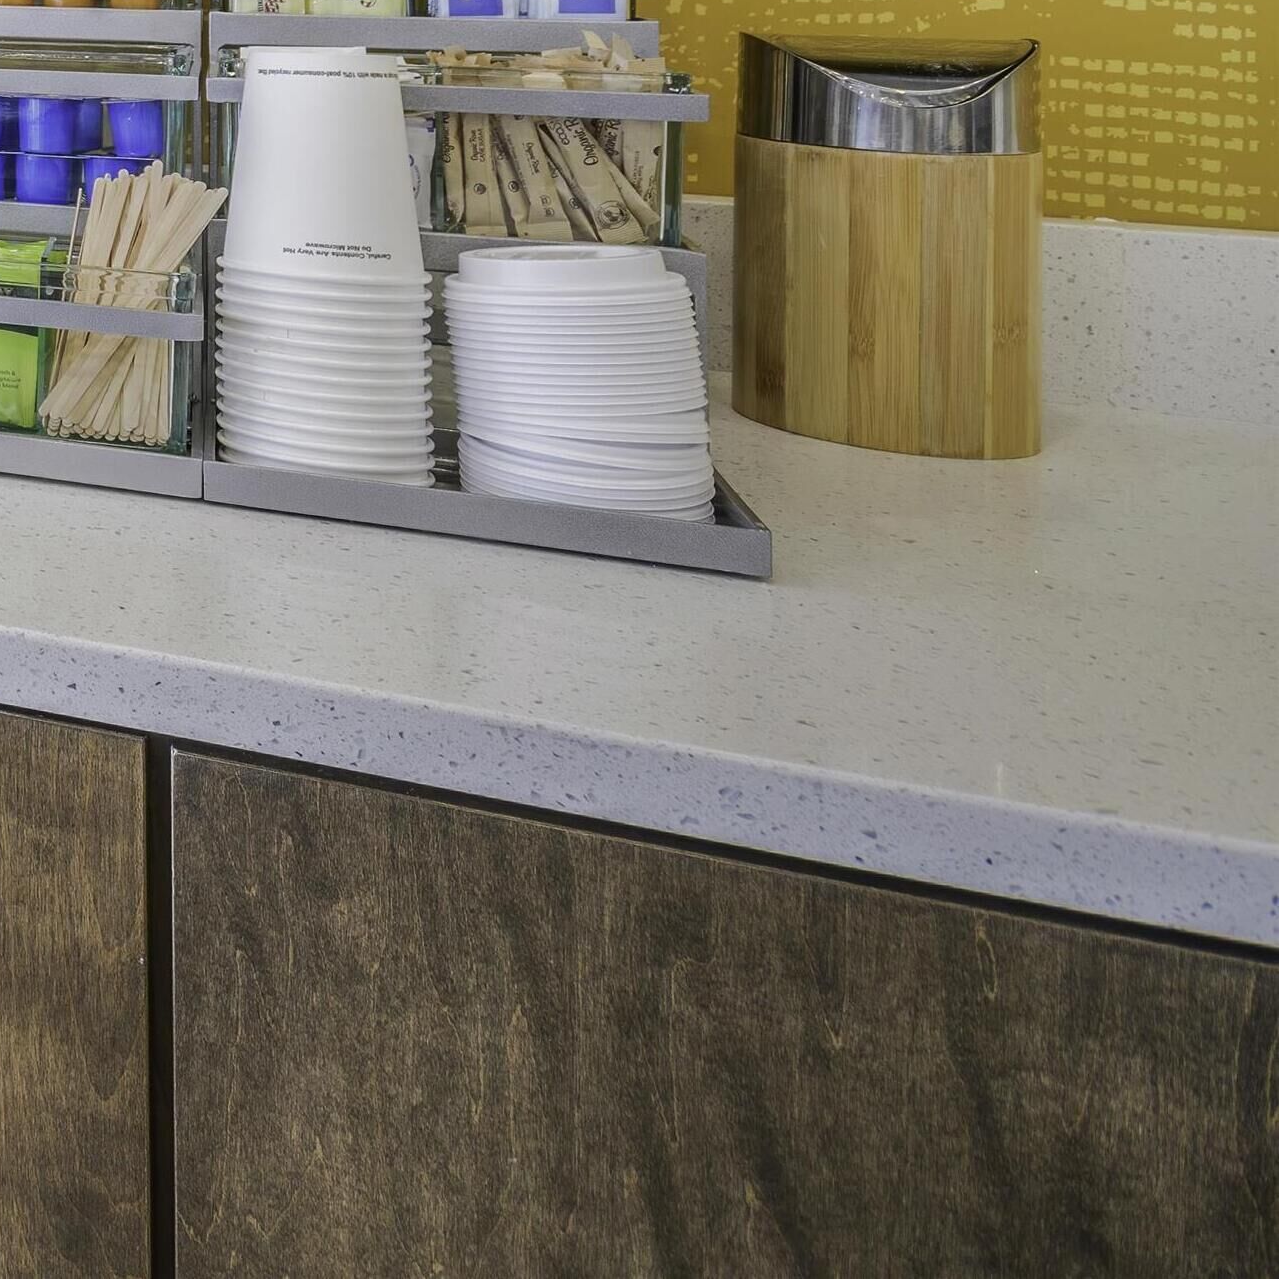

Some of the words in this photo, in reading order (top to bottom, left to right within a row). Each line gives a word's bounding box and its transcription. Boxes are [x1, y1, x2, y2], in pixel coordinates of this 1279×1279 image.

[573, 128, 599, 166] Organic
[305, 242, 345, 251] Microwave
[297, 248, 314, 256] Very
[331, 251, 365, 260] Contents
